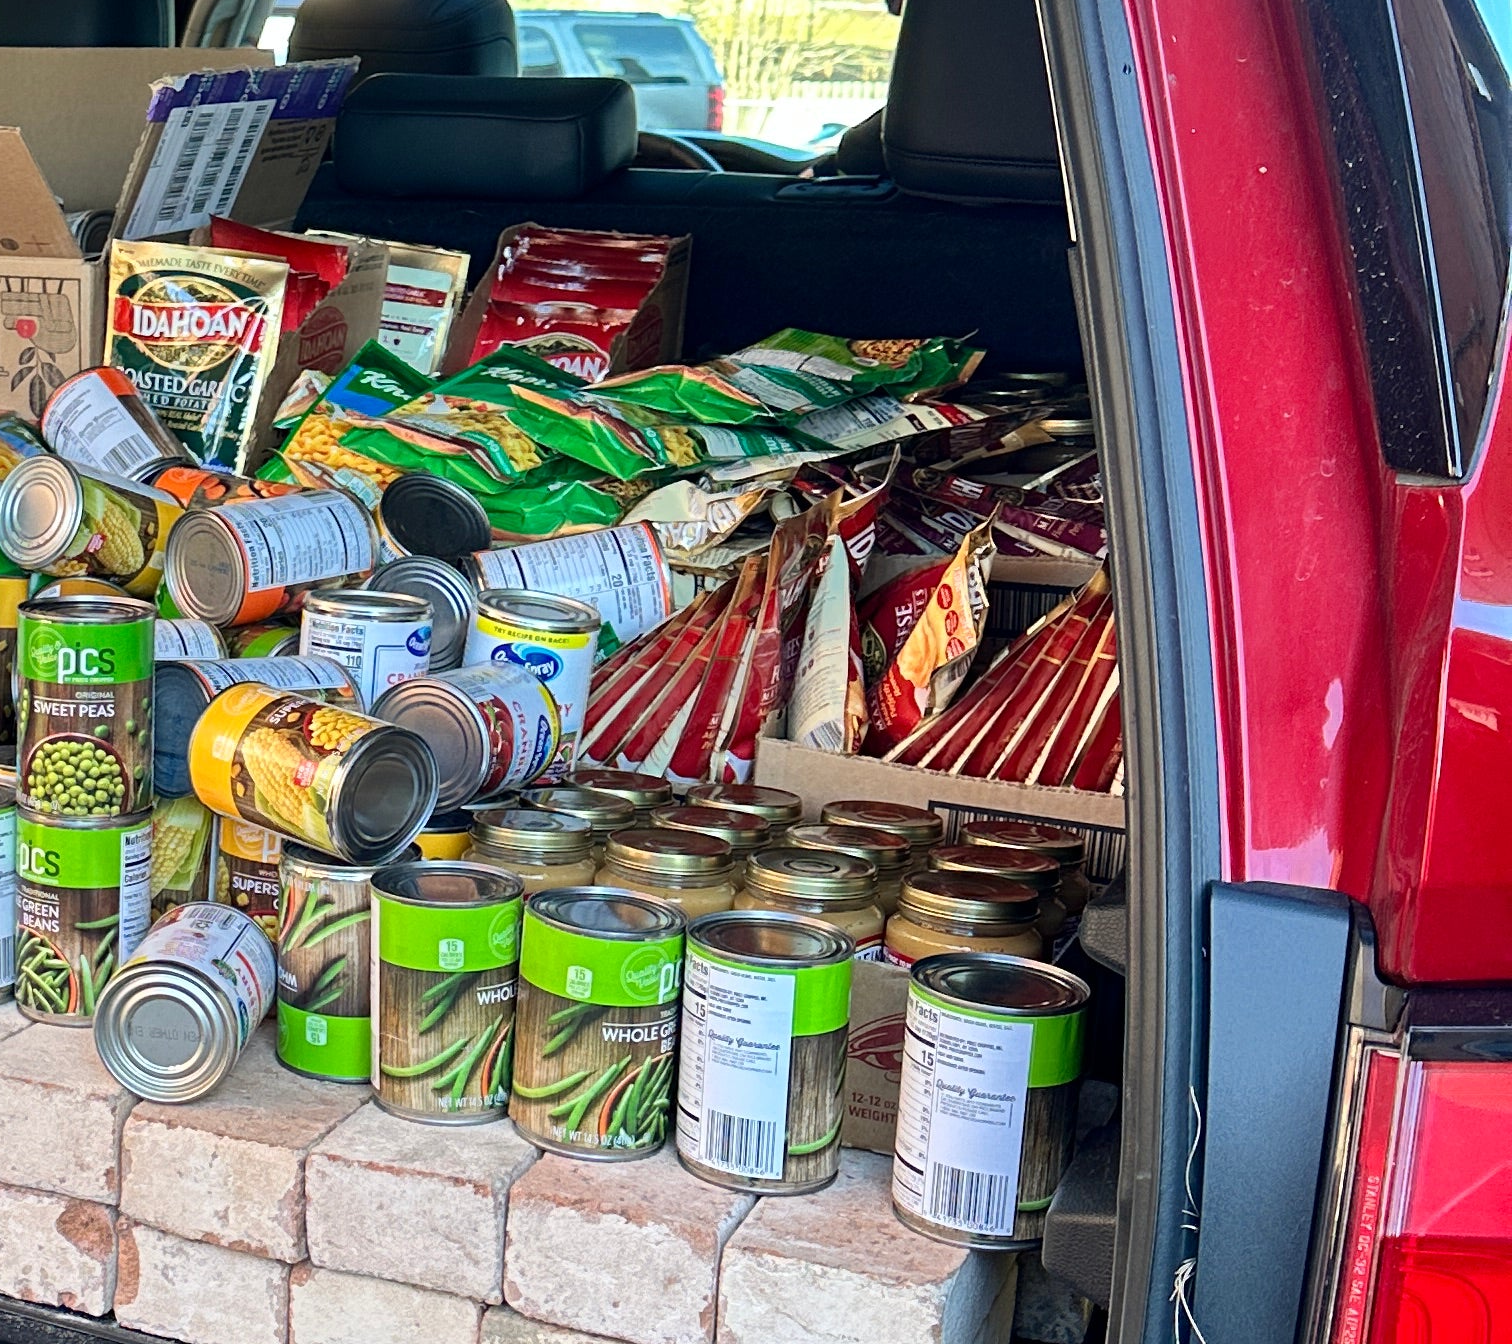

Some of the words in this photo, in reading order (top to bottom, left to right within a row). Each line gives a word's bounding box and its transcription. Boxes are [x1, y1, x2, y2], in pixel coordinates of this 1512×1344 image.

[186, 258, 212, 271] TASTE
[214, 264, 241, 282] EVERY
[241, 271, 266, 289] TIME
[133, 306, 248, 338] IDAHOAN
[250, 546, 259, 588] Nutrition
[644, 555, 657, 582] Facts
[611, 574, 624, 587] 20
[311, 618, 340, 632] Nutrition
[341, 623, 364, 636] Facts
[493, 626, 506, 635] TRY
[507, 630, 534, 642] RECIPE
[535, 635, 547, 643] ON
[58, 642, 116, 684] pics
[345, 654, 363, 667] 110
[75, 692, 115, 700] ORIGINAL
[34, 700, 76, 717] SWEET
[79, 704, 115, 718] PEAS
[19, 840, 61, 877] pics
[21, 885, 60, 900] TRADITIONAL
[232, 875, 279, 897] SUPERS
[22, 898, 60, 918] GREEN
[23, 913, 60, 933] BEANS
[445, 941, 458, 952] 15
[574, 968, 585, 979] 15
[626, 964, 657, 983] Quality
[477, 983, 519, 1006] WHOL
[695, 1001, 706, 1018] 15
[914, 1000, 939, 1023] Facts
[311, 1033, 321, 1044] 15
[602, 1026, 659, 1043] WHOLE
[707, 1029, 734, 1045] Quality
[735, 1038, 780, 1051] Guarantee
[921, 1050, 934, 1067] 15
[851, 1092, 881, 1107] 12-12
[935, 1078, 965, 1096] Quality
[967, 1087, 1017, 1102] Guarantee
[438, 1096, 452, 1107] NET
[455, 1097, 468, 1107] WT
[848, 1106, 897, 1124] WEIGHT
[552, 1125, 568, 1138] NET
[569, 1129, 582, 1142] WT
[583, 1131, 600, 1145] 14.5
[600, 1134, 612, 1145] OZ
[1360, 1175, 1380, 1231] STANLEY
[1348, 1278, 1364, 1305] SAE
